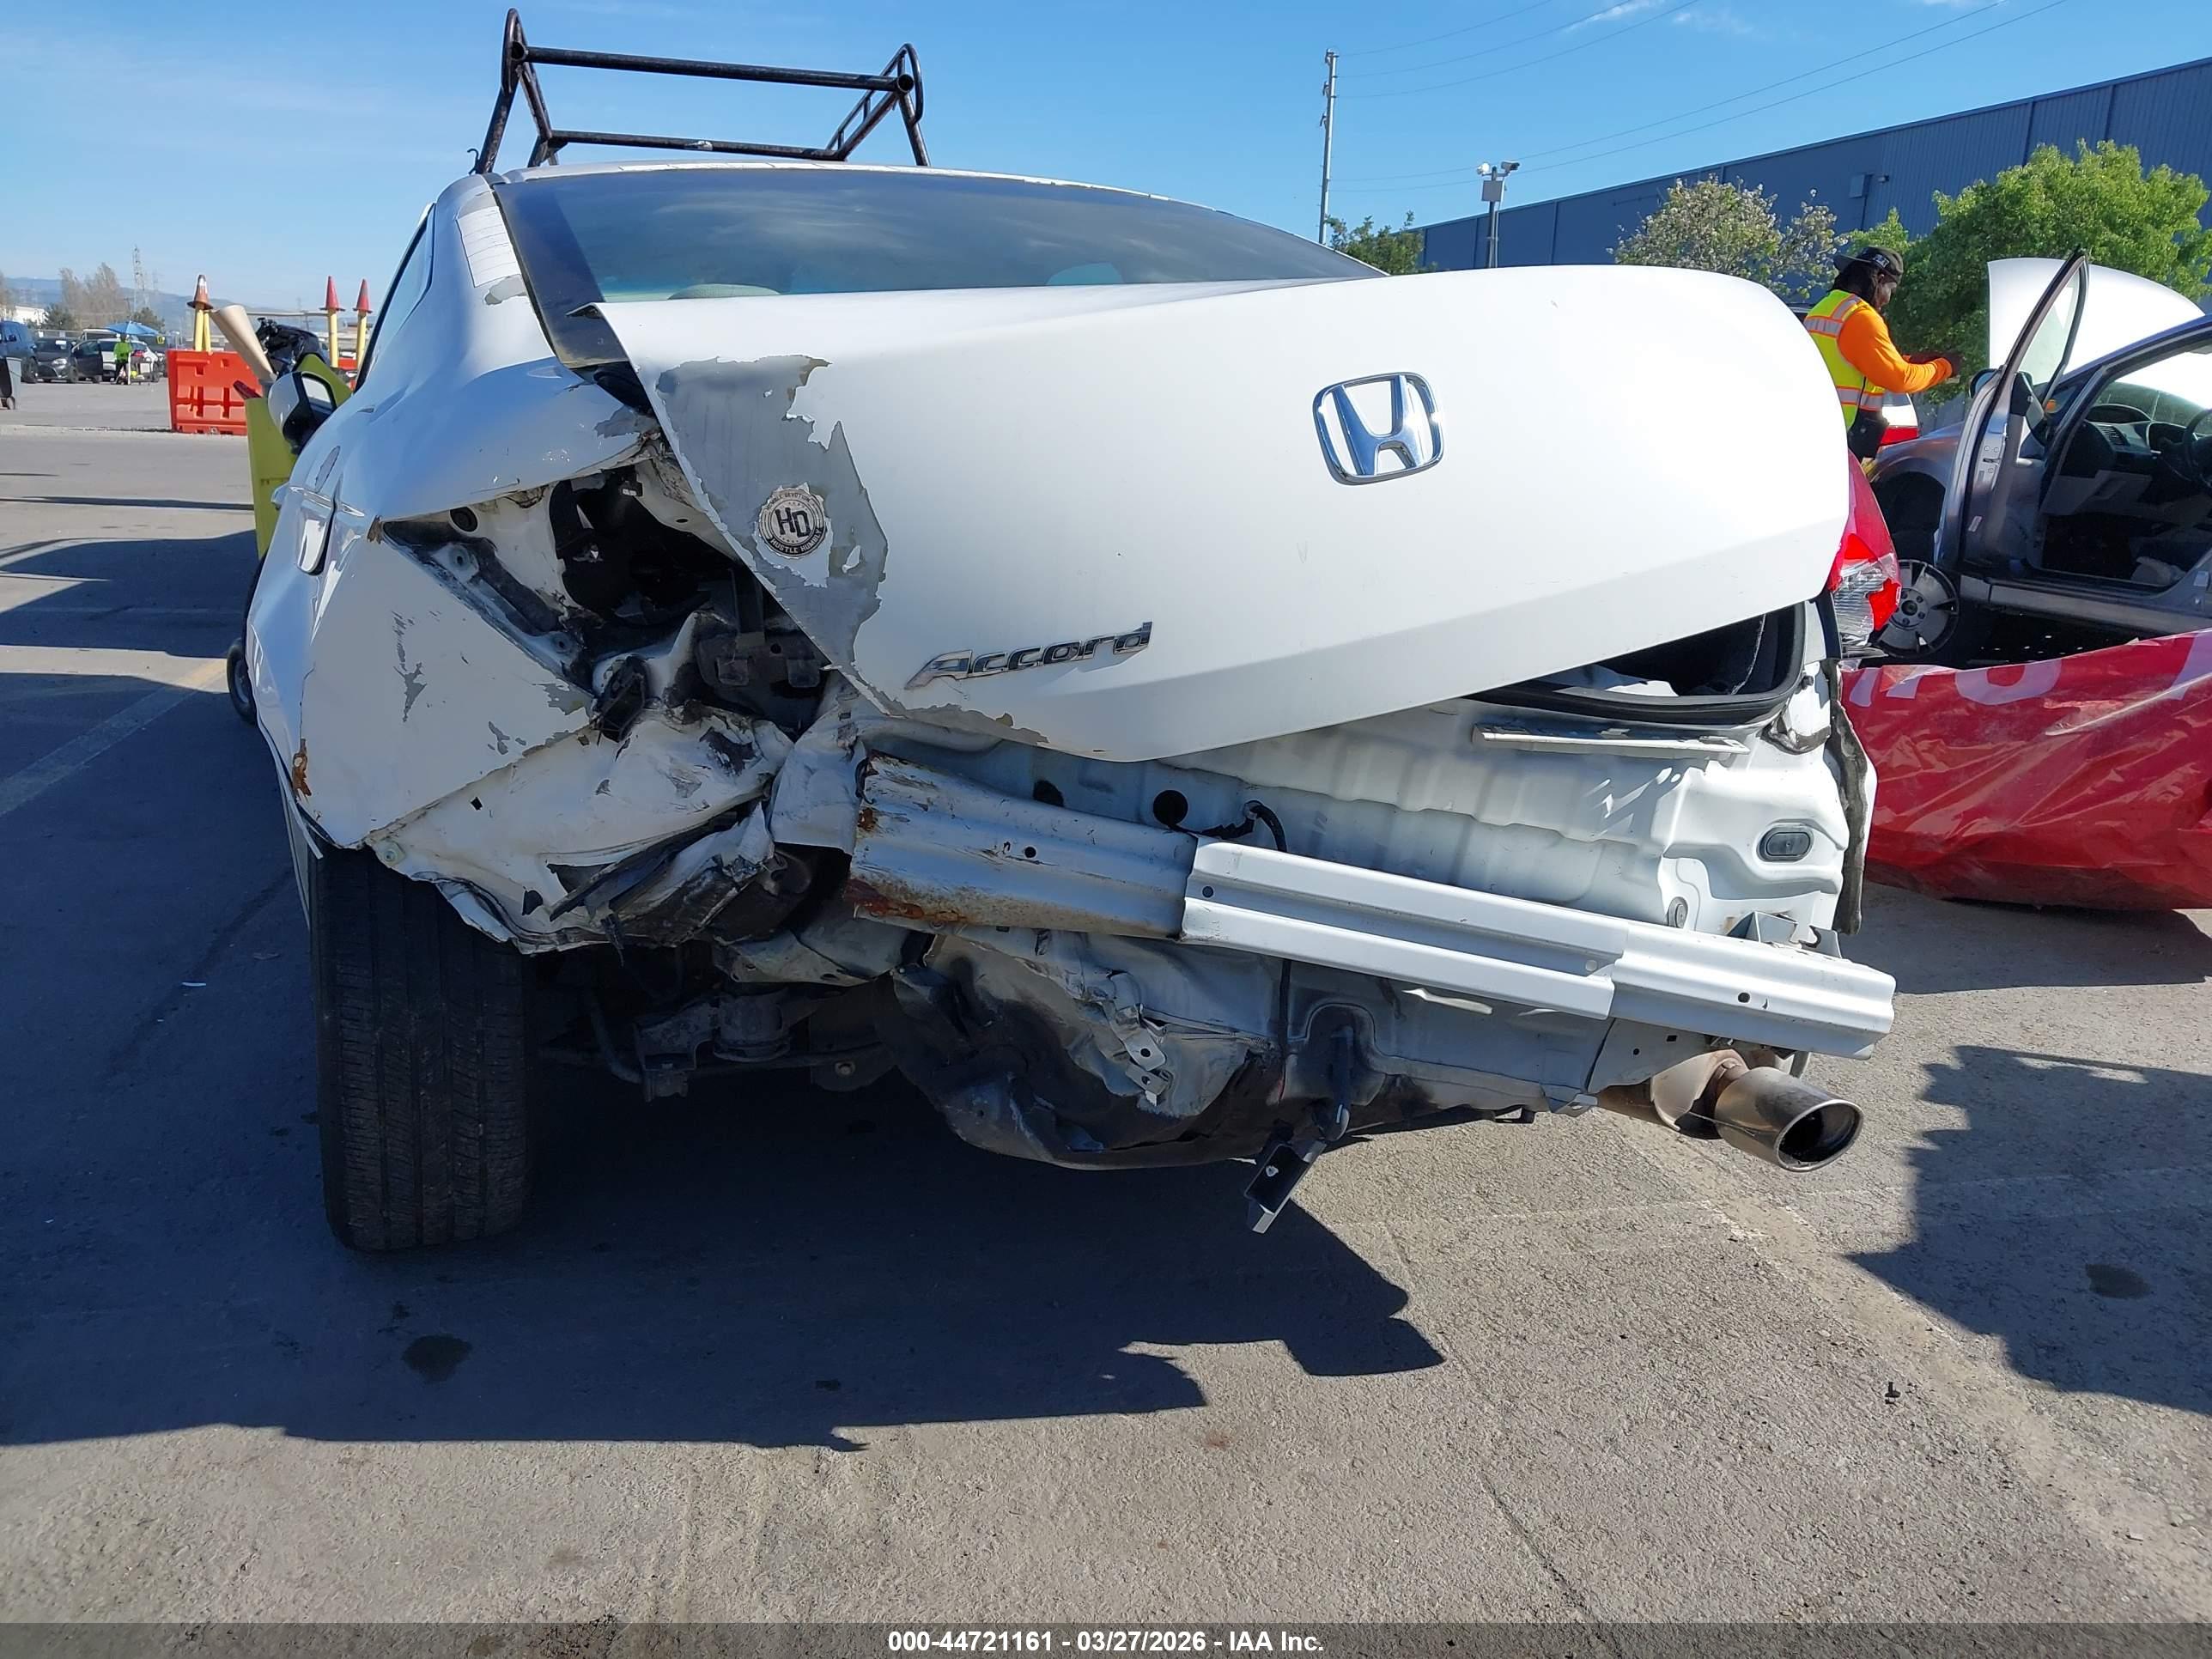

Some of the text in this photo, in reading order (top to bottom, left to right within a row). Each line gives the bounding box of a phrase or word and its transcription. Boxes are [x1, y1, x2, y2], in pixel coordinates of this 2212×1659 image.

[775, 507, 811, 538] HD
[770, 528, 823, 554] HUSTLE HUMBLY
[903, 621, 1153, 690] Accord
